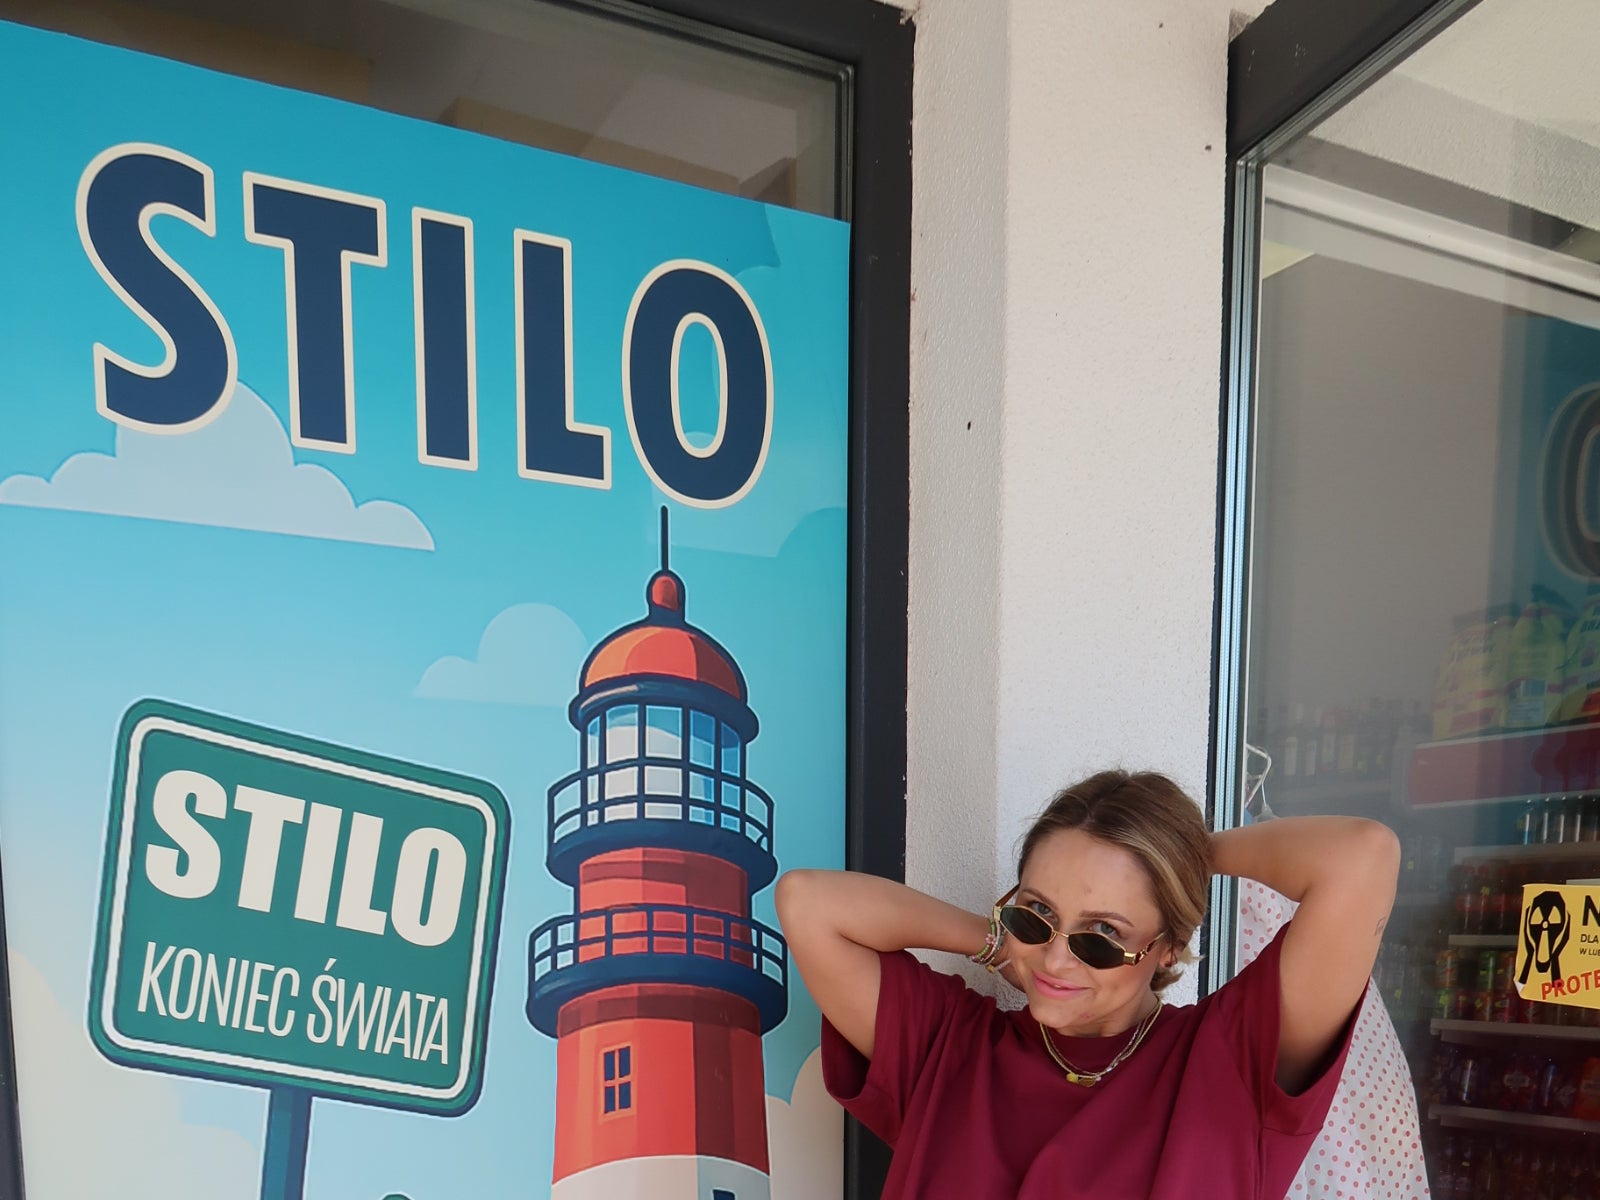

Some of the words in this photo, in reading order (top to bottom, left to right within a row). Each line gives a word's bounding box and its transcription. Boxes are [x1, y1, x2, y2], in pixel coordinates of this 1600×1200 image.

[76, 142, 774, 509] STILO
[145, 770, 467, 946] STILO
[137, 941, 300, 1037] KONIEC
[306, 958, 449, 1065] ŚWIATA
[1581, 933, 1599, 944] DLA
